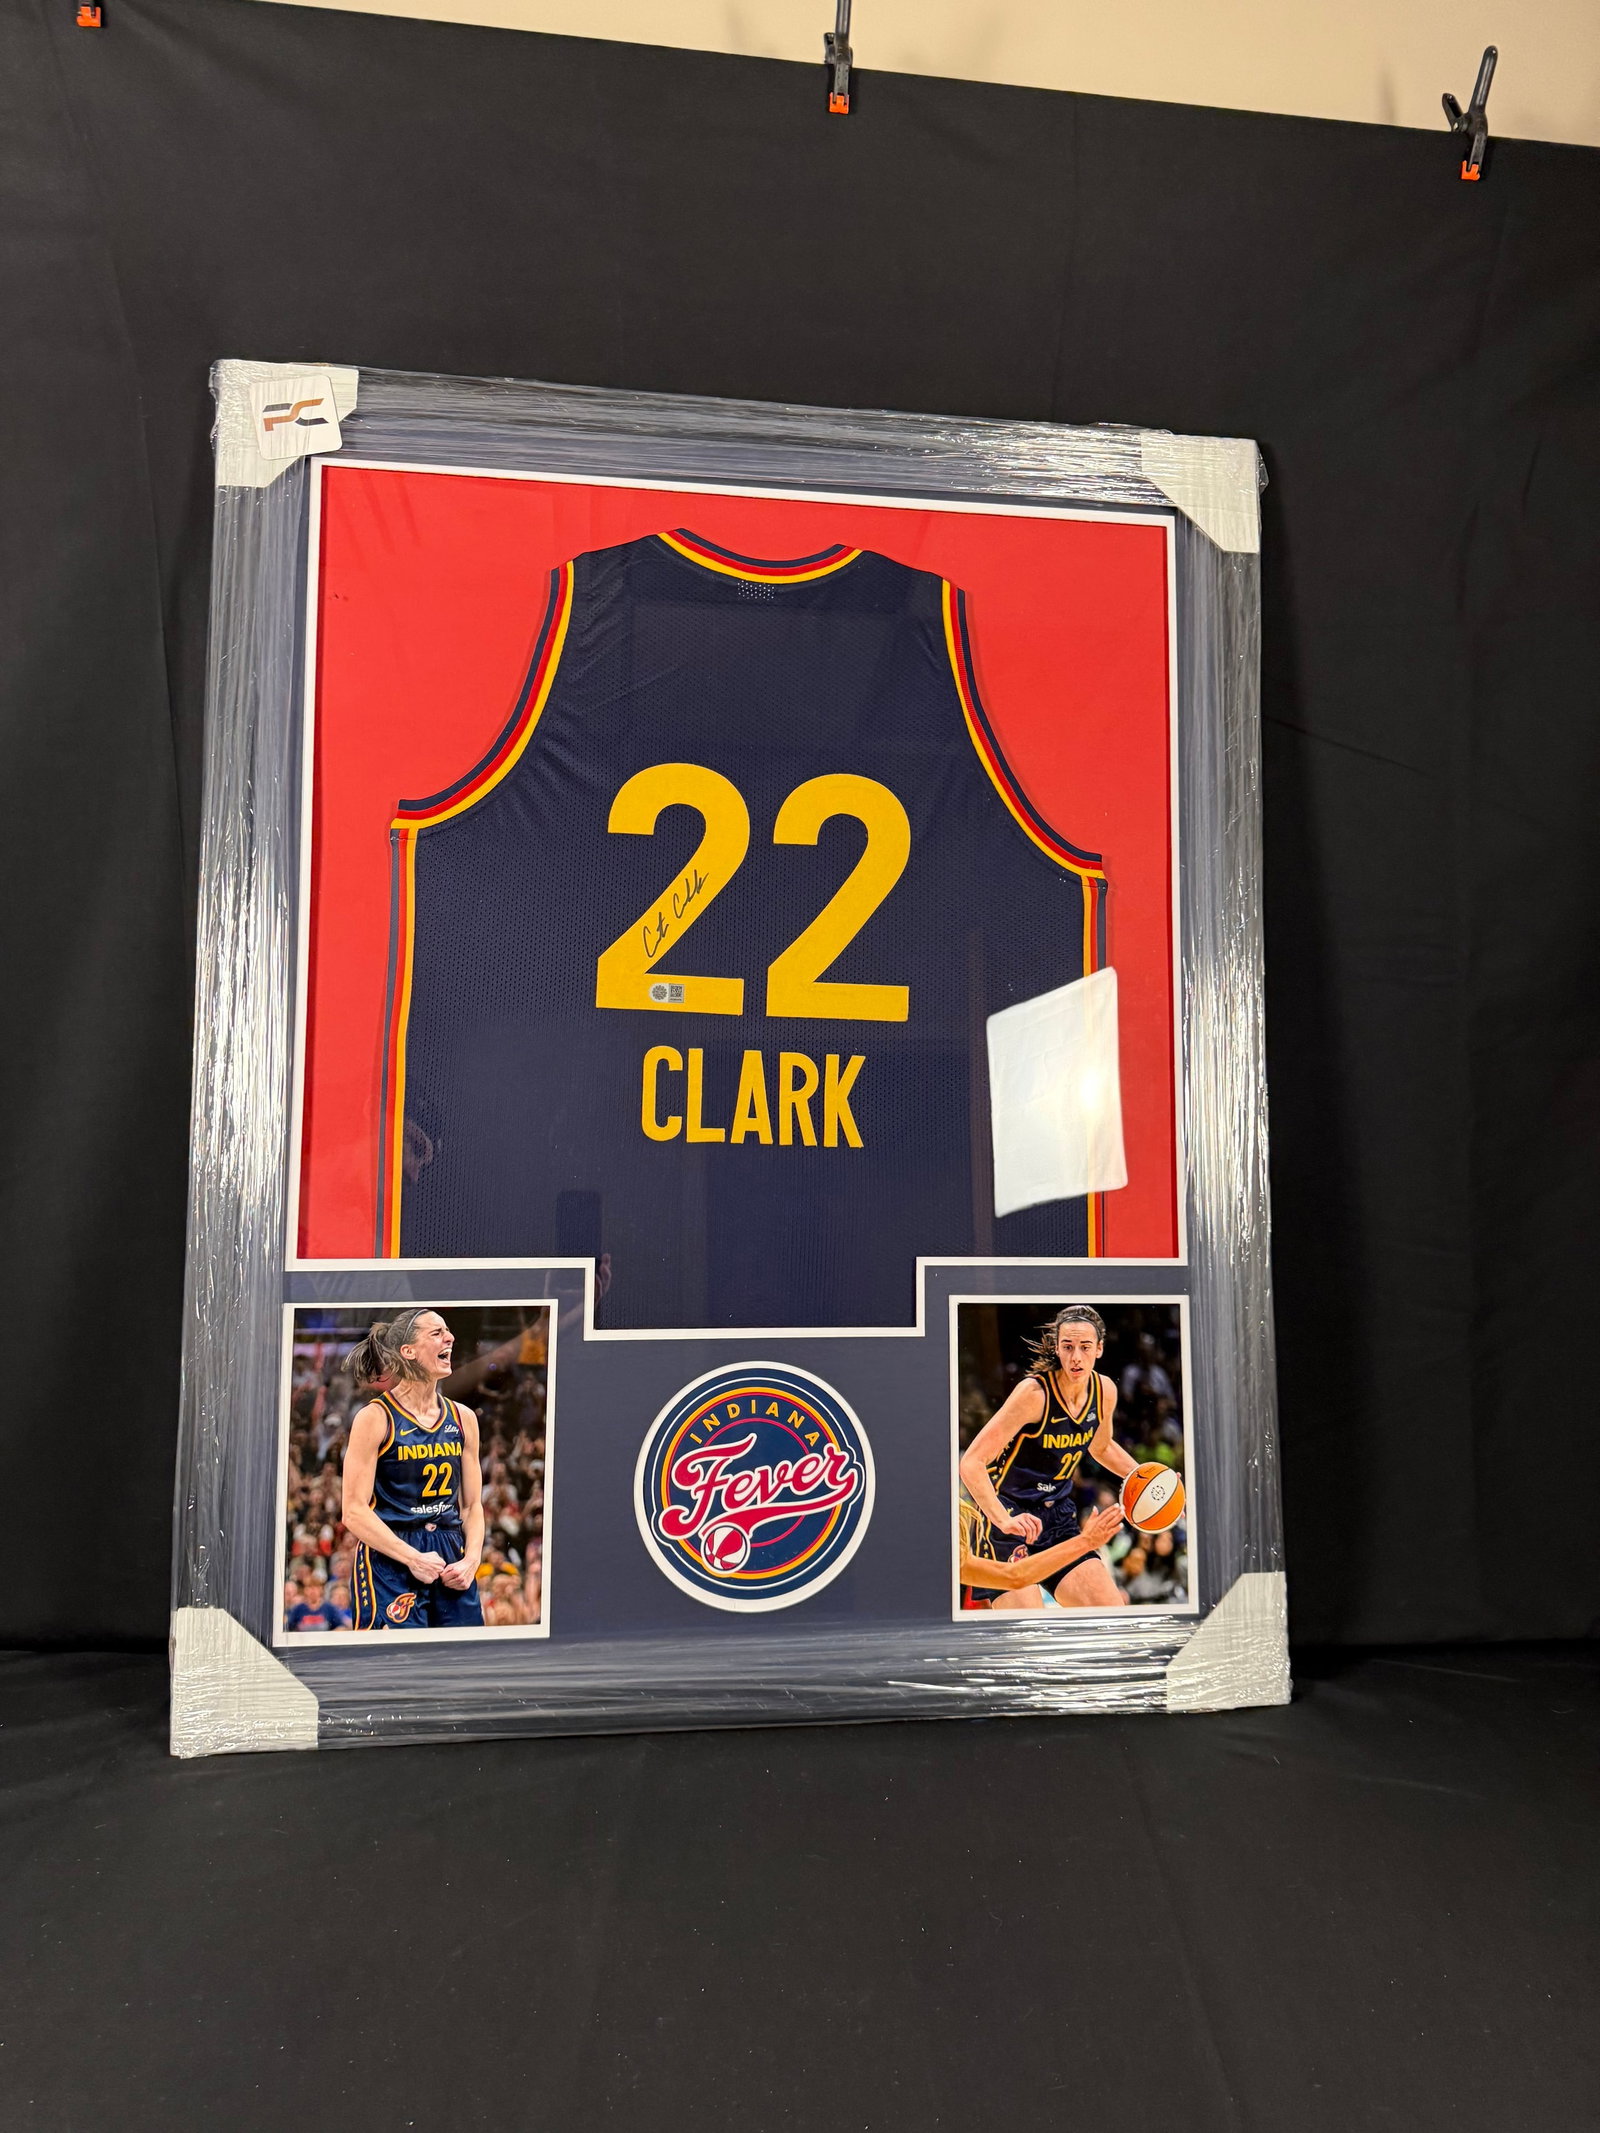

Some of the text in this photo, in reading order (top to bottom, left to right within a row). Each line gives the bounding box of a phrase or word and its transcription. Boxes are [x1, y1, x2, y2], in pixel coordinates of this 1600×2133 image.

[596, 763, 911, 1022] 22
[642, 1045, 865, 1149] CLARK
[689, 1399, 820, 1447] INDIANA
[398, 1442, 463, 1461] INDIANA
[1053, 1450, 1083, 1481] 22
[422, 1462, 453, 1498] 22
[659, 1432, 857, 1540] Fever
